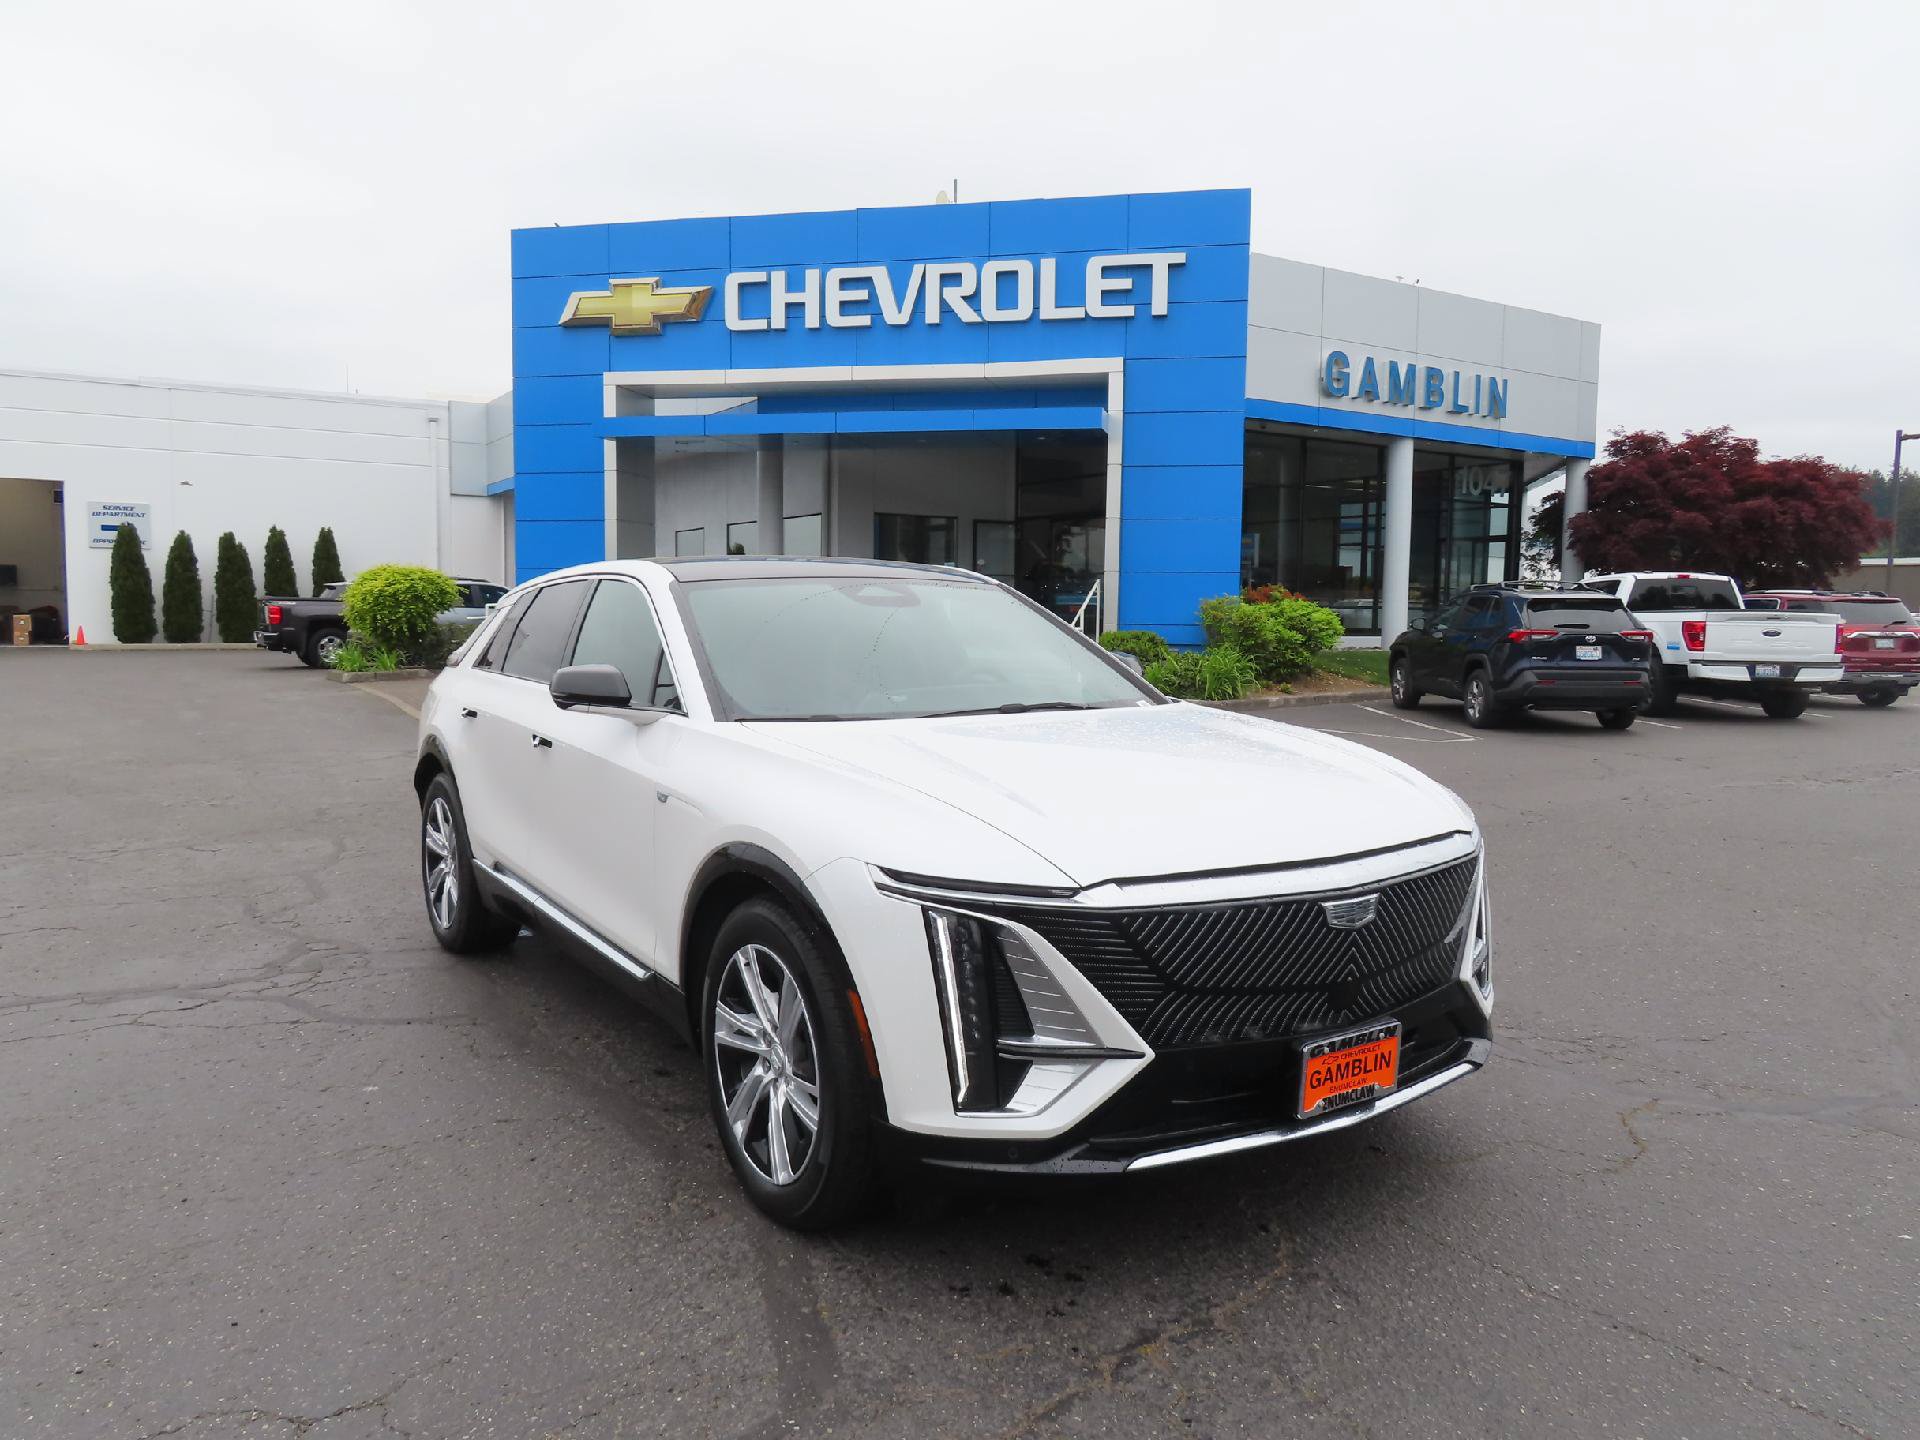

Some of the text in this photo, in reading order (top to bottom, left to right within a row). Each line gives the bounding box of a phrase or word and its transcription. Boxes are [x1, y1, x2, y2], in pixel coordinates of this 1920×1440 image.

[724, 252, 1186, 331] CHEVROLET
[1323, 350, 1509, 419] GAMBLIN
[1461, 465, 1512, 498] 1047
[102, 504, 135, 512] SERVICE
[1340, 1044, 1381, 1060] CHEVROLET
[1310, 1050, 1392, 1090] GAMBLIN
[1329, 1077, 1368, 1094] ENUMCLAW
